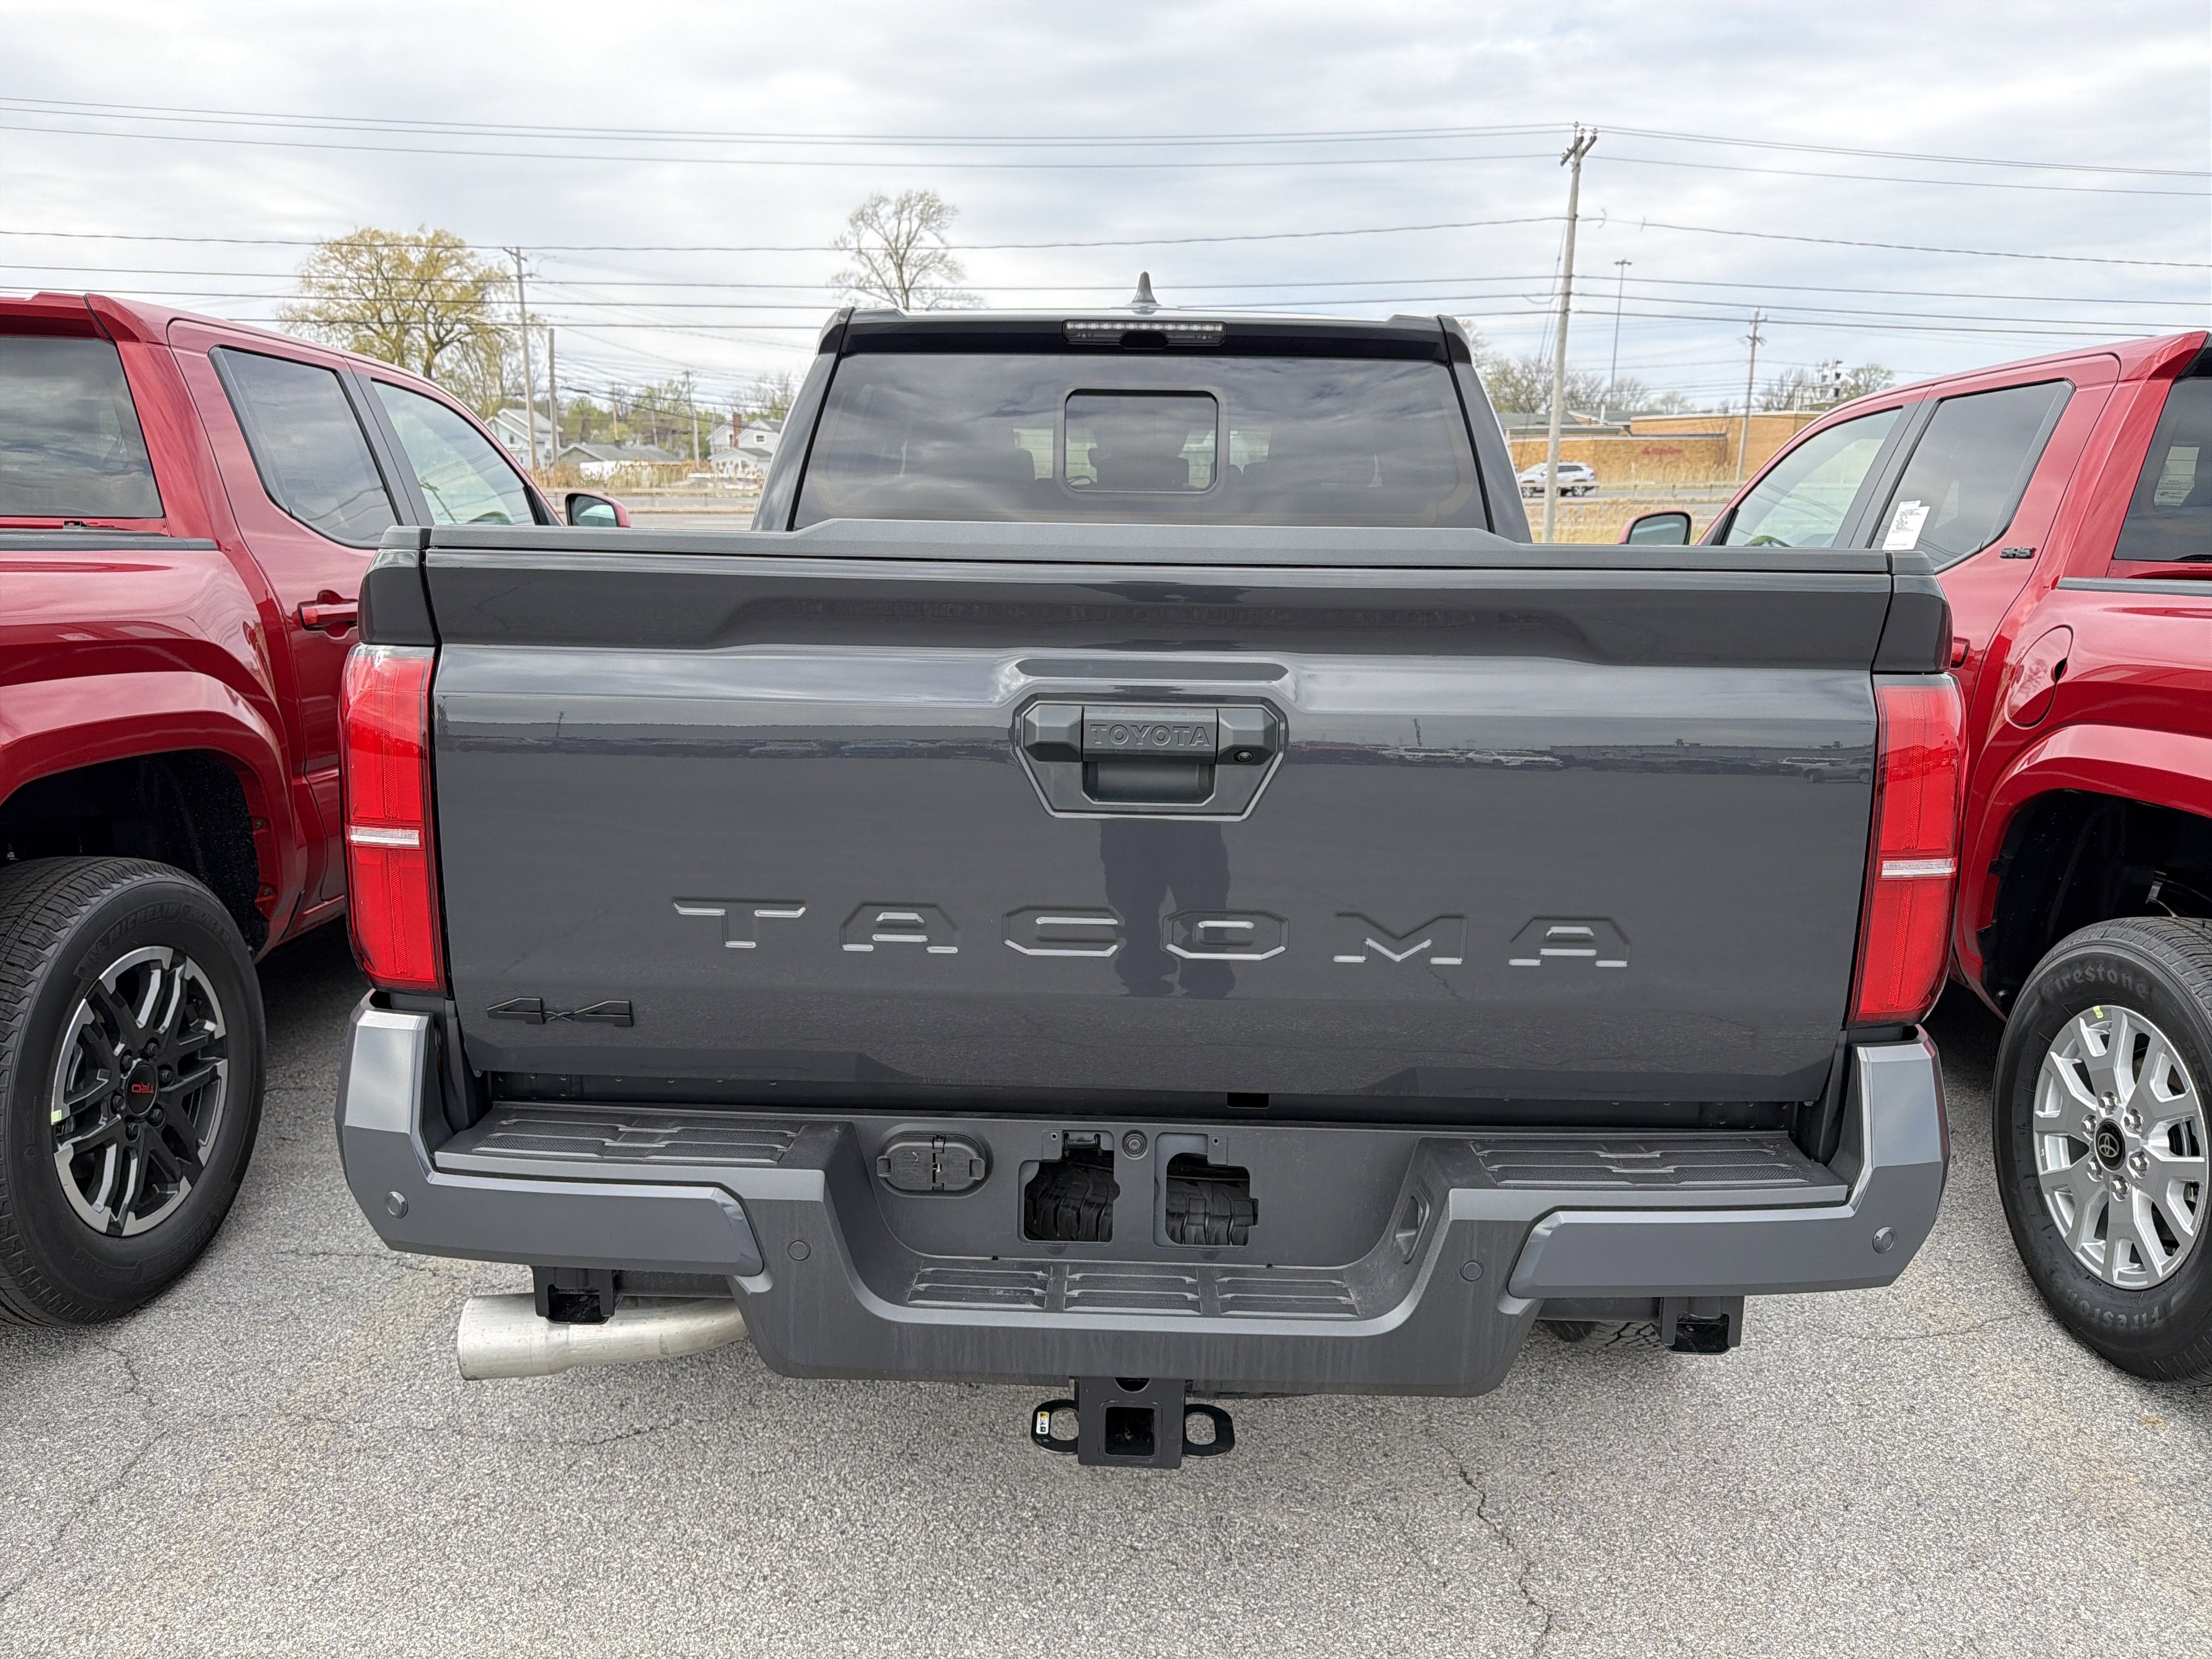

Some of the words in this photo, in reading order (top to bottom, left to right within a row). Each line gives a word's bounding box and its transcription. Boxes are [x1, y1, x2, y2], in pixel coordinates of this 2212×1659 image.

[2000, 547, 2036, 558] SR5
[1090, 723, 1210, 747] TOYOTA
[672, 898, 1631, 967] TACOMA
[2040, 963, 2149, 1000] Firestone
[132, 1082, 154, 1094] TRD
